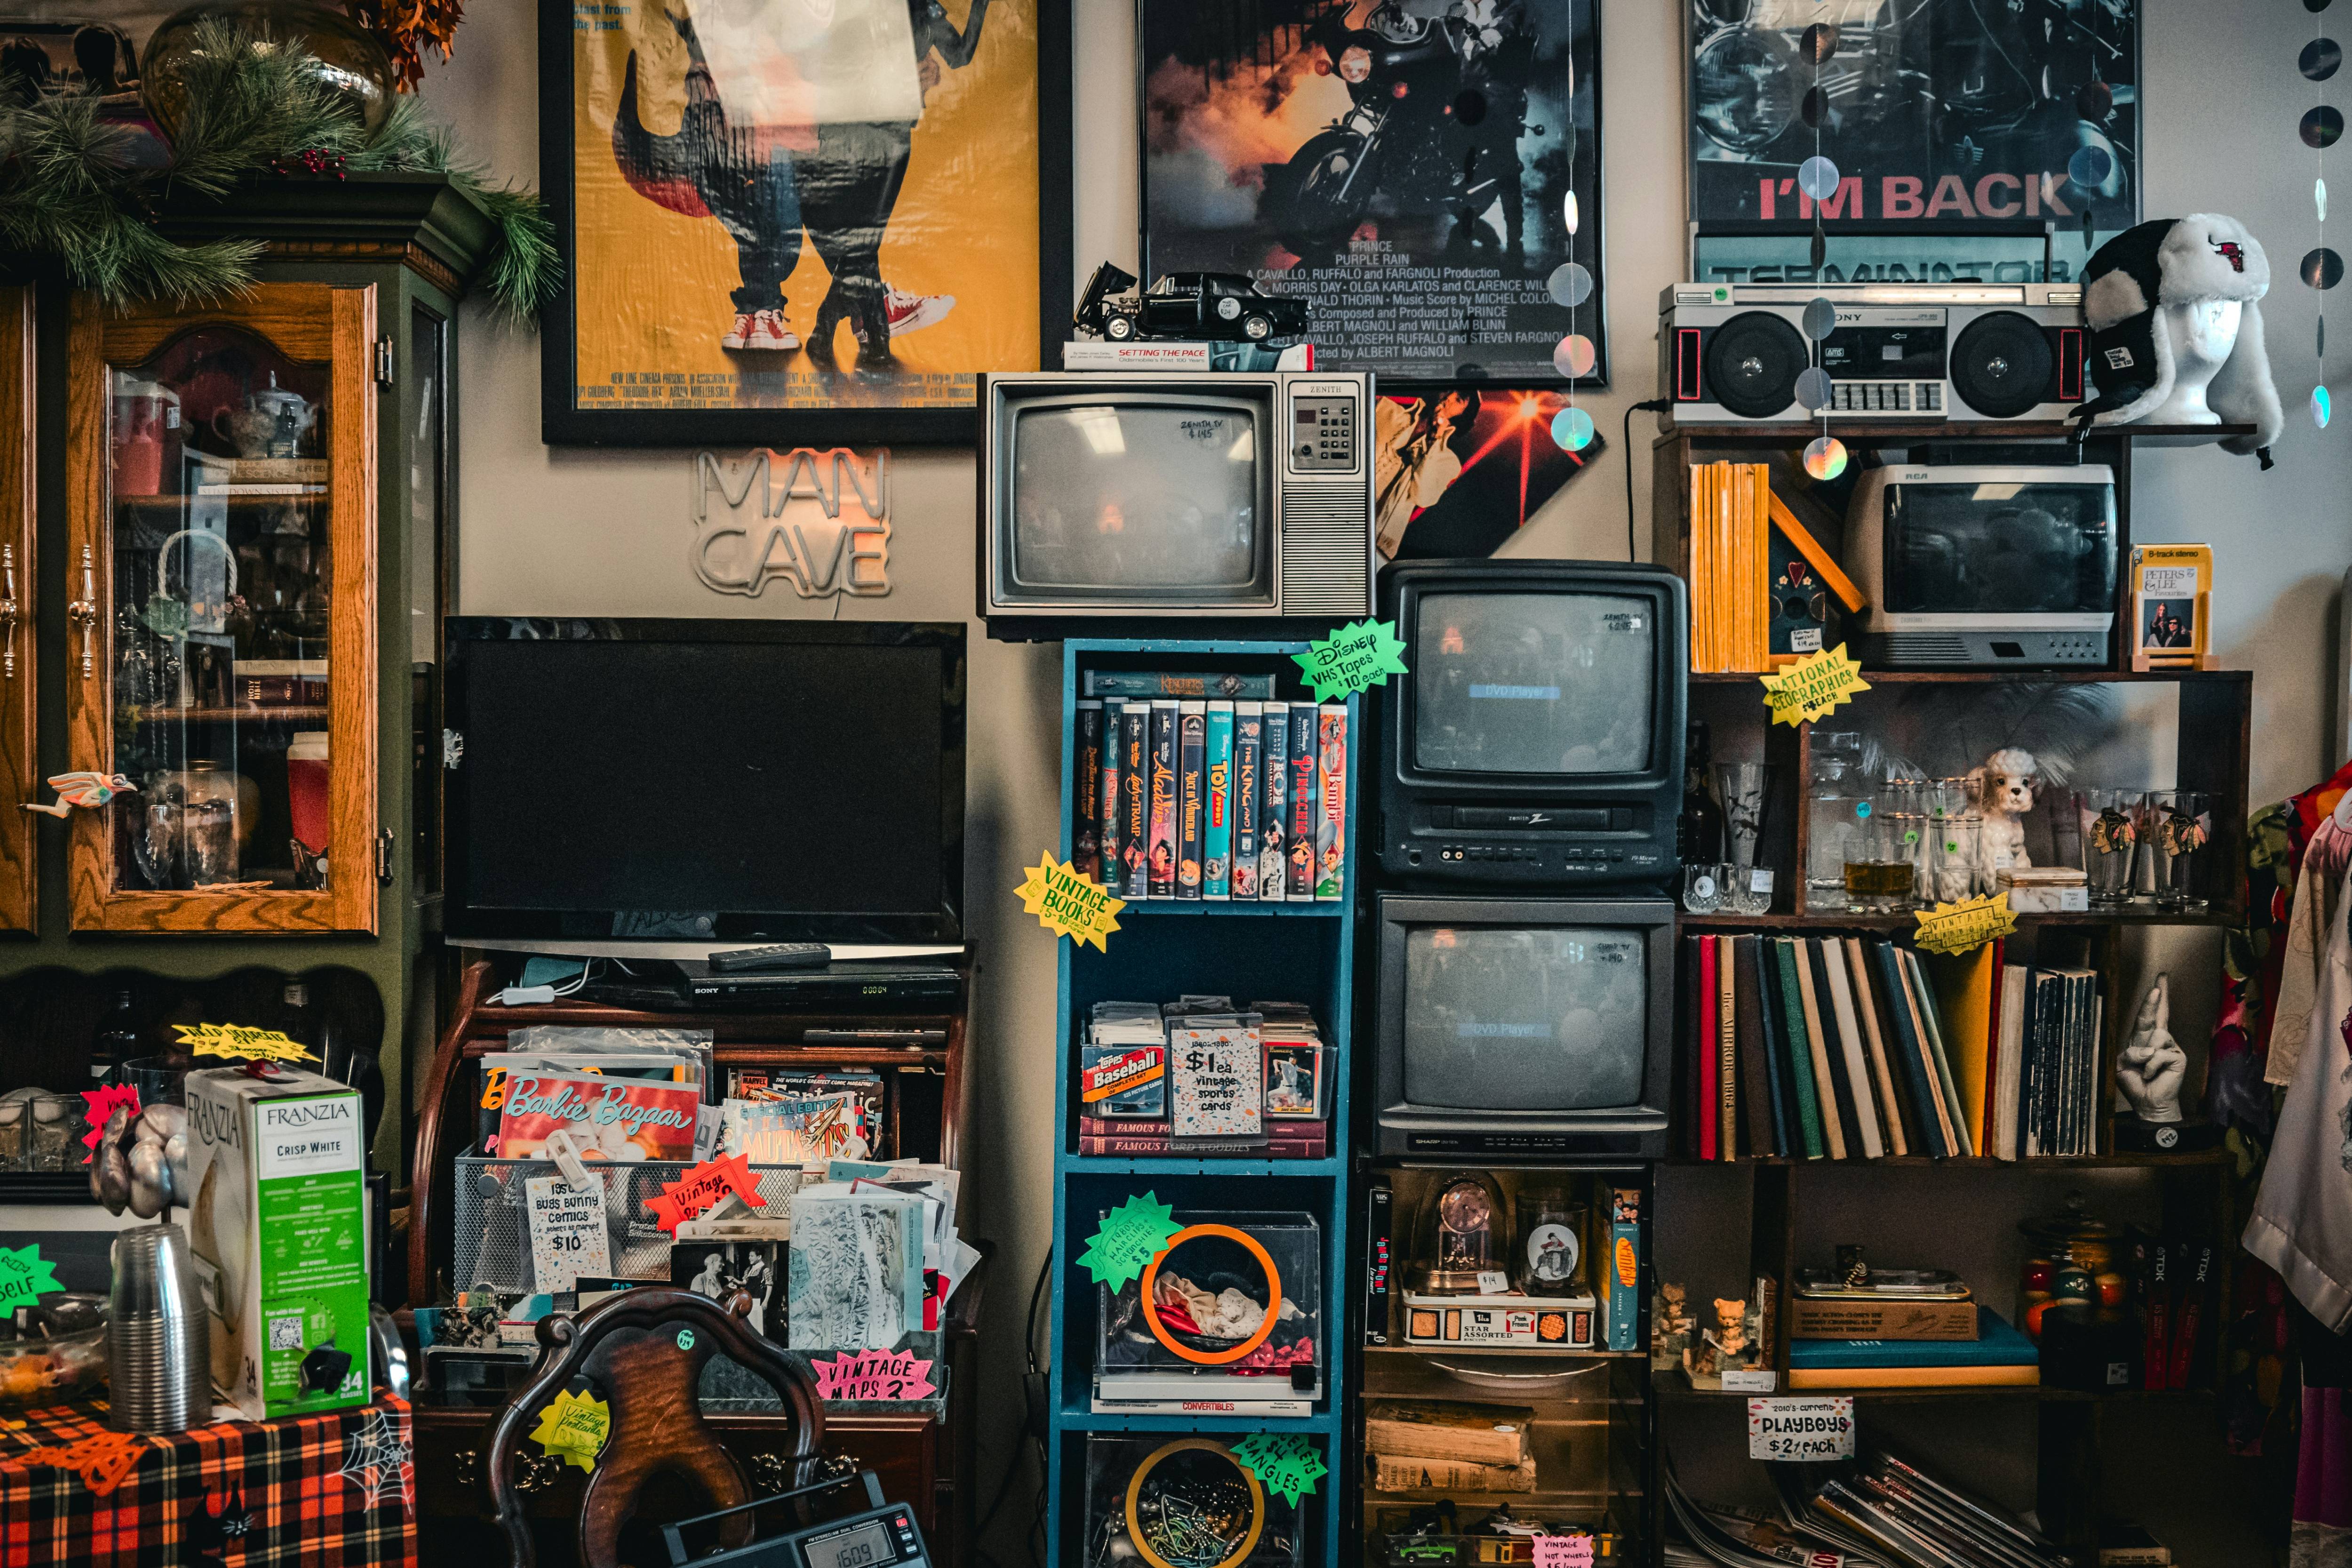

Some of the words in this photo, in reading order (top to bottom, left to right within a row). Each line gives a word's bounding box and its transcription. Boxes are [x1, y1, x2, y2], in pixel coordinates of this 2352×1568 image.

[605, 4, 631, 15] from
[1760, 177, 1863, 220] I'M
[1882, 173, 2074, 219] BACK
[1352, 241, 1392, 252] PRINCE
[1336, 255, 1379, 265] PURPLE
[1383, 255, 1409, 265] RAIN
[1257, 269, 1310, 281] CAVALLO,
[1313, 269, 1361, 279] RUFFALO
[1364, 269, 1383, 279] and
[1386, 268, 1440, 279] FARGNOLI
[1444, 267, 1500, 279] Production
[1272, 283, 1317, 293] MORRIS
[1320, 282, 1341, 293] DAY
[1350, 282, 1380, 293] OLGA
[1383, 281, 1439, 292] KARLATOS
[1442, 281, 1461, 291] and
[1464, 280, 1521, 291] CLARENCE
[1342, 294, 1384, 305] THORIN
[1393, 294, 1424, 305] Music
[1427, 294, 1456, 304] Score
[1460, 294, 1472, 307] by
[1475, 293, 1517, 304] MICHEL
[1319, 308, 1374, 320] Composed
[1377, 308, 1396, 318] and
[1400, 307, 1448, 318] Produced
[1452, 307, 1464, 319] by
[1468, 306, 1508, 317] PRINCE
[1344, 321, 1396, 332] MAGNOLI
[1399, 321, 1417, 331] and
[1421, 319, 1469, 330] WILLIAM
[1473, 319, 1505, 330] BLINN
[1351, 334, 1393, 345] JOSEPH
[1397, 334, 1446, 344] RUFFALO
[1448, 334, 1467, 343] and
[1470, 333, 1513, 343] STEVEN
[1342, 347, 1354, 360] by
[1357, 346, 1400, 358] ALBERT
[1403, 346, 1454, 357] MAGNOLI
[1181, 420, 1211, 429] ZENITH
[698, 450, 884, 518] MAN
[700, 525, 885, 591] CAVE
[2145, 570, 2185, 580] PETERS
[2158, 579, 2177, 589] LEE
[1311, 668, 1338, 685] VHS
[1335, 654, 1374, 676] Tapes
[1338, 674, 1361, 689] $10
[1362, 666, 1386, 683] each
[1770, 655, 1845, 692] NATIONAL
[1512, 686, 1543, 697] Player
[1772, 669, 1854, 711] GEOGRAPHICS
[1816, 692, 1838, 707] EACH
[1125, 772, 1143, 796] Lady
[1152, 751, 1175, 824] Aladdin
[1210, 760, 1228, 798] TOY
[1241, 764, 1254, 806] KING
[1291, 755, 1314, 834] PINOCCHIO
[1325, 771, 1342, 820] Bambi
[1130, 801, 1141, 837] TRAMP
[1045, 865, 1111, 913] VINTAGE
[1042, 888, 1095, 926] BOOKS
[1931, 908, 1992, 931] VINTAGE
[1723, 991, 1734, 1010] the
[185, 1027, 223, 1037] HELP
[1723, 1018, 1734, 1072] MIRROR
[1094, 1050, 1155, 1088] Baseball
[1185, 1050, 1215, 1073] $1
[1216, 1064, 1232, 1074] ea
[1107, 1076, 1136, 1090] COMPLETE
[1196, 1075, 1237, 1086] vintage
[1198, 1090, 1235, 1098] sports
[1724, 1082, 1735, 1109] 1964
[267, 1103, 350, 1127] FRANZIA
[505, 1075, 591, 1121] Barbie
[594, 1083, 693, 1136] Bazaar
[740, 1105, 794, 1119] SPECIAL
[1201, 1101, 1232, 1111] cards
[187, 1091, 240, 1149] FRANZIA
[1116, 1123, 1155, 1133] FAMOUS
[277, 1145, 307, 1157] CRISP
[310, 1141, 341, 1154] WHITE
[1114, 1142, 1161, 1151] FAMOUS
[675, 1174, 725, 1206] Vintage
[552, 1236, 581, 1251] $10
[1109, 1240, 1128, 1260] HAIR
[2155, 1256, 2165, 1281] TDK
[2195, 1256, 2210, 1282] TDK
[1482, 1275, 1497, 1285] $14
[340, 1369, 364, 1393] 34
[829, 1359, 916, 1383] VINTAGE
[831, 1380, 879, 1400] MAPS
[565, 1405, 606, 1427] Vintage
[1182, 1402, 1235, 1411] CONVERTIBLES
[1762, 1417, 1848, 1433] PLAYBOYS
[1245, 1440, 1300, 1492] BANGLES
[814, 1529, 839, 1541] STEREO/AM
[852, 1519, 879, 1530] CONVERSION
[836, 1543, 873, 1568] 1609
